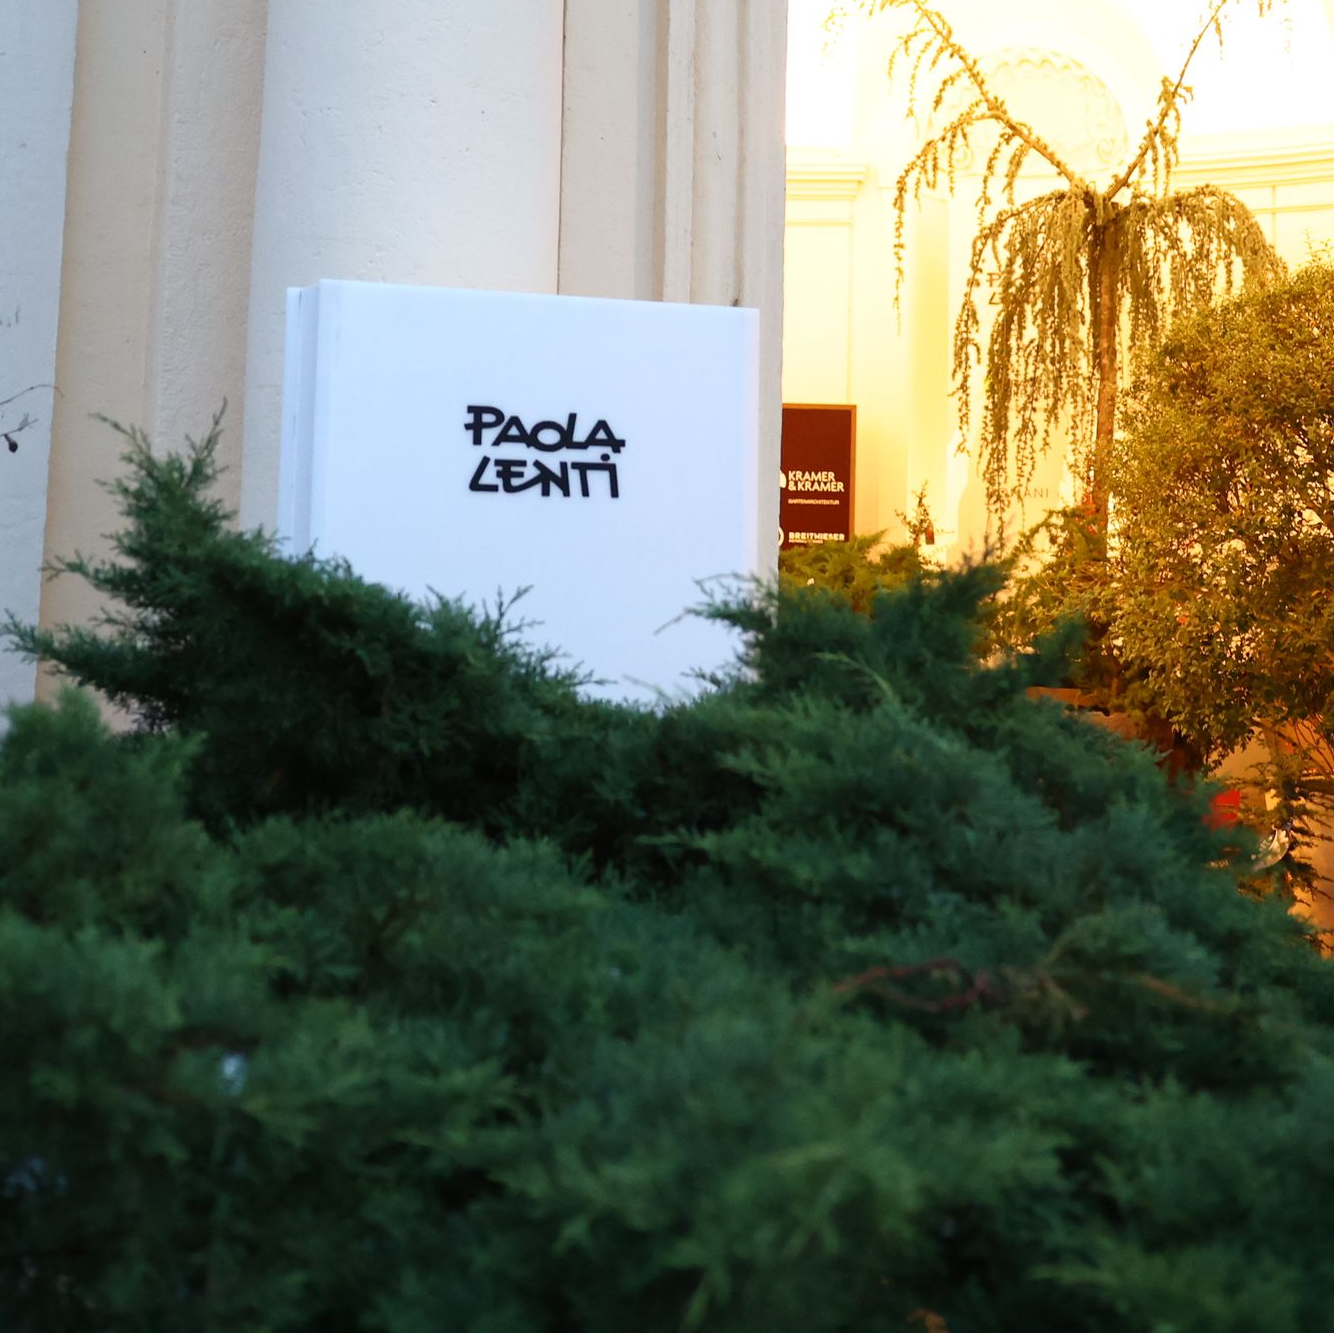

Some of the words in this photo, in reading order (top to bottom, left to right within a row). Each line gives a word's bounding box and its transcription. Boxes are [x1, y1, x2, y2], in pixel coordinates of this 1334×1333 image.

[464, 405, 626, 454] PAOLA
[788, 470, 835, 481] KRAMER
[788, 481, 797, 491] &
[798, 481, 845, 492] KRAMER
